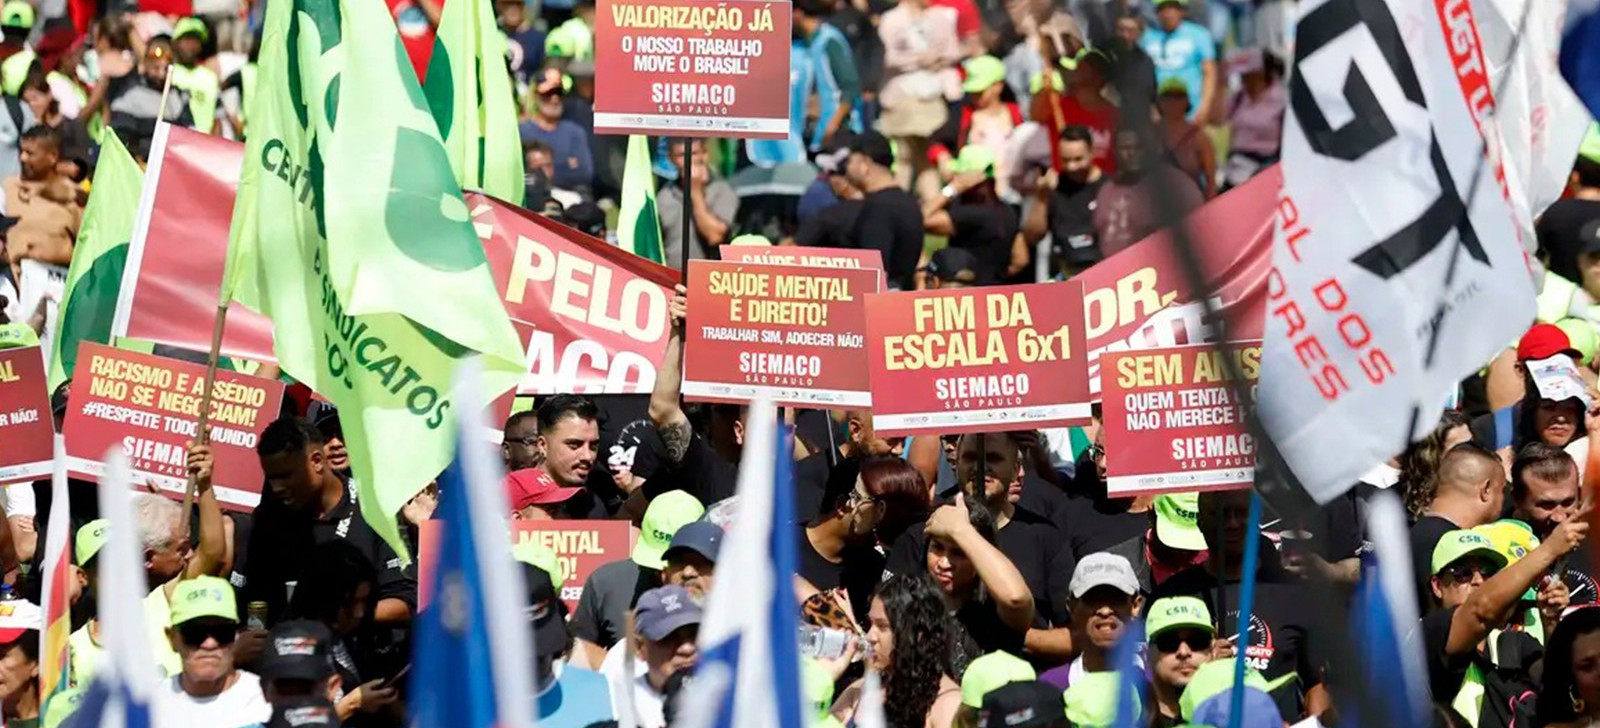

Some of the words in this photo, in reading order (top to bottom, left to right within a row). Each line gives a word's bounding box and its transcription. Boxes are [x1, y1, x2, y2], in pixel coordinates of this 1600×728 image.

[612, 3, 742, 36] VALORIZAÇÃO
[748, 4, 774, 32] JÁ
[622, 36, 633, 53] O
[636, 37, 684, 54] NOSSO
[688, 38, 763, 57] TRABALHO
[634, 55, 676, 73] MOVE
[680, 57, 690, 73] O
[694, 58, 749, 75] BRASIL!
[651, 83, 736, 105] SIEMACO
[658, 103, 681, 113] SÃO
[688, 105, 728, 115] PAULO
[505, 234, 667, 343] PELO
[709, 267, 770, 298] SAÚDE
[775, 275, 853, 301] MENTAL
[748, 300, 827, 327] DIREITO!
[914, 295, 976, 333] FIM
[986, 292, 1033, 328] DA
[702, 326, 758, 342] TRABALHAR
[761, 330, 783, 345] SIM,
[786, 332, 834, 347] ADOECER
[837, 333, 863, 348] NÃO!
[1312, 278, 1396, 385] DOS
[884, 330, 1008, 371] ESCALA
[1017, 325, 1071, 363] 6x1
[90, 355, 172, 389] RACISMO
[175, 373, 189, 392] E
[739, 352, 821, 377] SIEMACO
[1116, 354, 1183, 389] SEM
[90, 376, 128, 401] NÃO
[131, 385, 156, 407] SE
[745, 373, 768, 384] SÃO
[774, 376, 813, 387] PAULO
[935, 373, 1030, 400] SIEMACO
[945, 400, 970, 410] SÃO
[979, 396, 1022, 408] PAULO
[1125, 391, 1174, 412] QUEM
[1178, 387, 1229, 407] TENTA
[10, 408, 39, 425] NÃO!
[82, 401, 161, 430] #RESPEITE
[210, 426, 257, 449] MUNDO
[1126, 408, 1160, 431] NÃO
[1166, 406, 1235, 426] MERECE
[123, 435, 188, 468] SIEMA
[607, 444, 638, 466] 24
[1171, 433, 1259, 461] SIEMAC
[1181, 459, 1207, 470] SÃO
[1459, 534, 1482, 544] CSB
[1166, 606, 1189, 617] CSB
